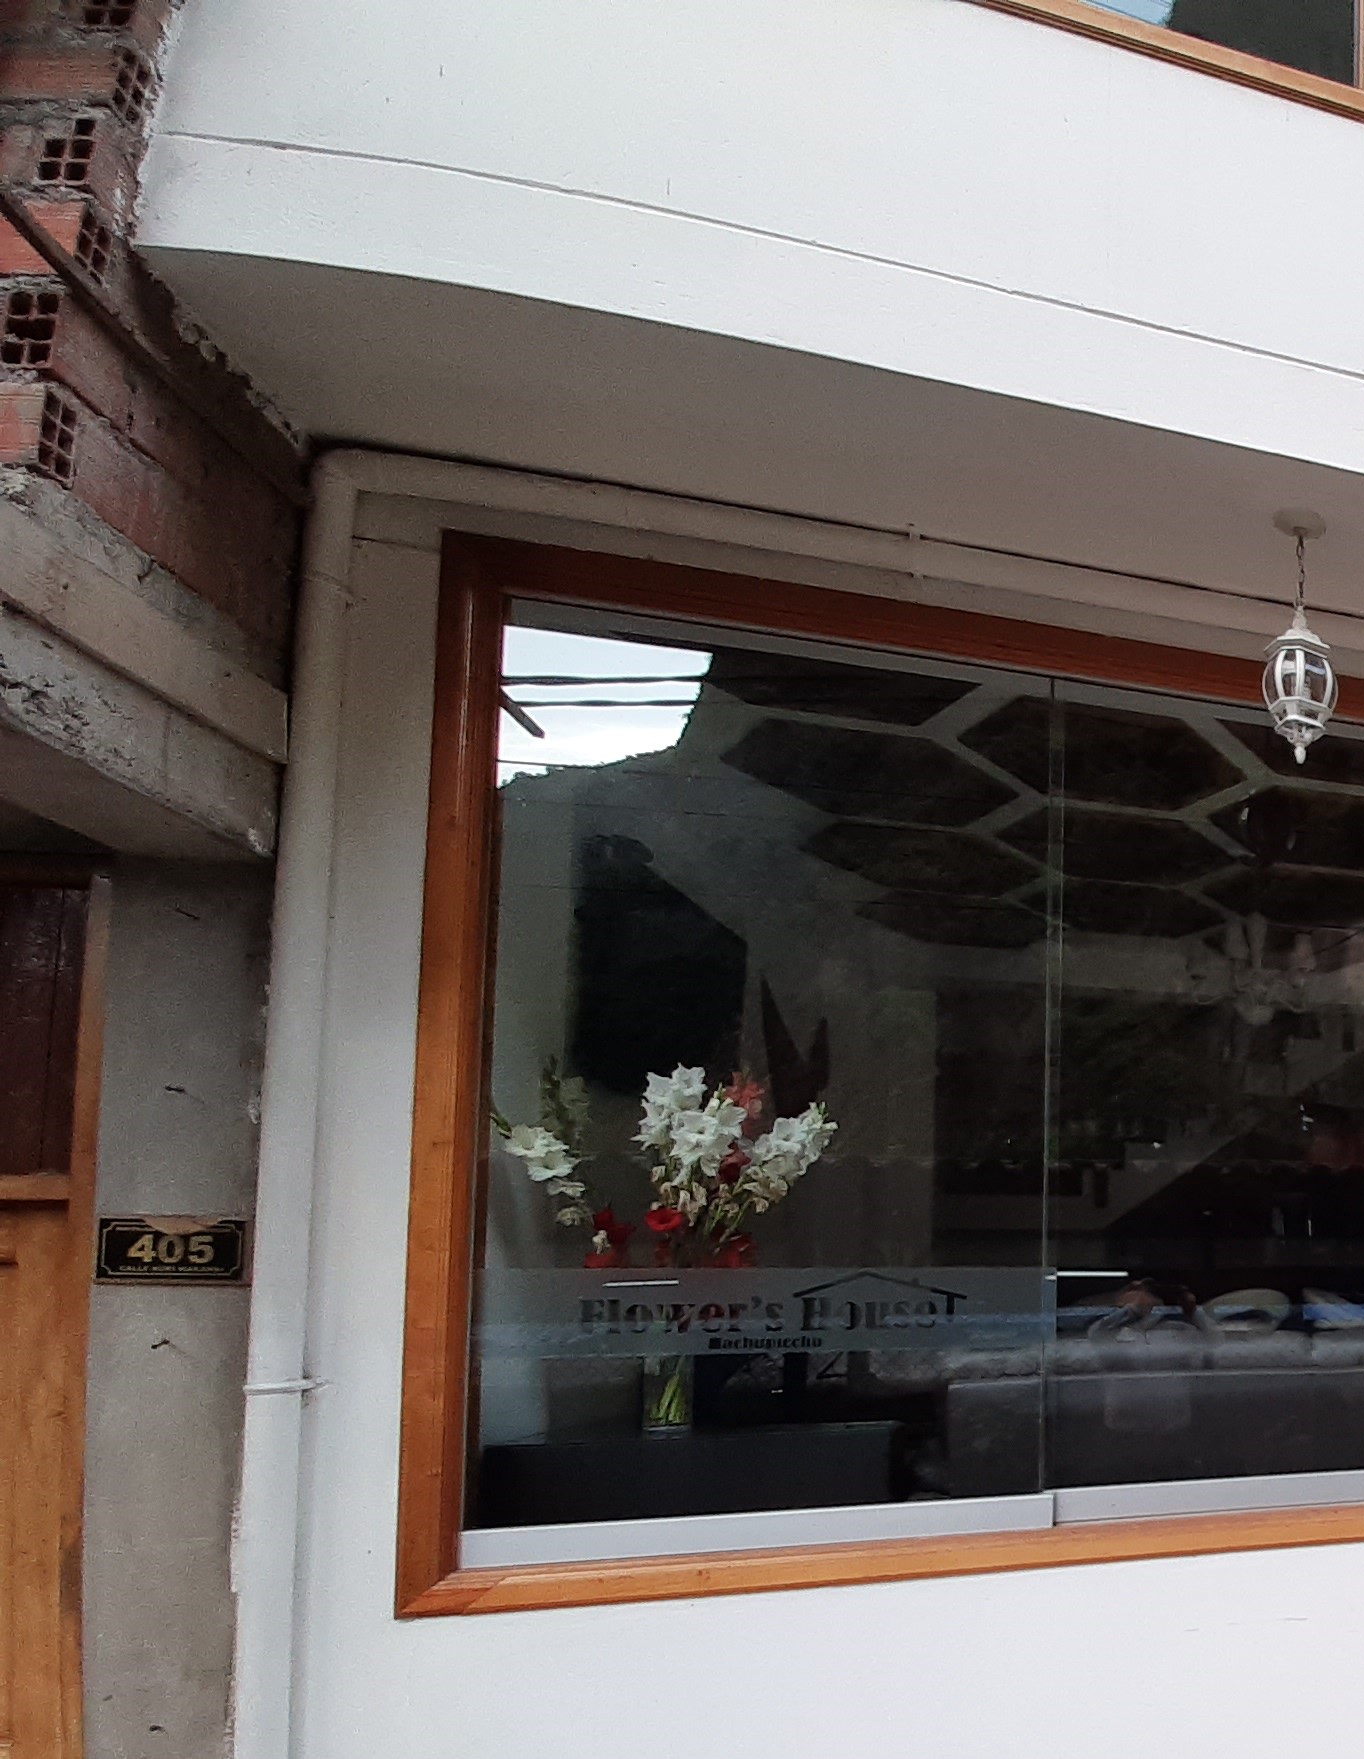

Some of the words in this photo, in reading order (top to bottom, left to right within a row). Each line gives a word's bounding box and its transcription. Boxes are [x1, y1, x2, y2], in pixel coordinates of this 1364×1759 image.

[127, 1234, 215, 1264] 405
[580, 1295, 784, 1334] Flower's
[799, 1296, 937, 1331] House
